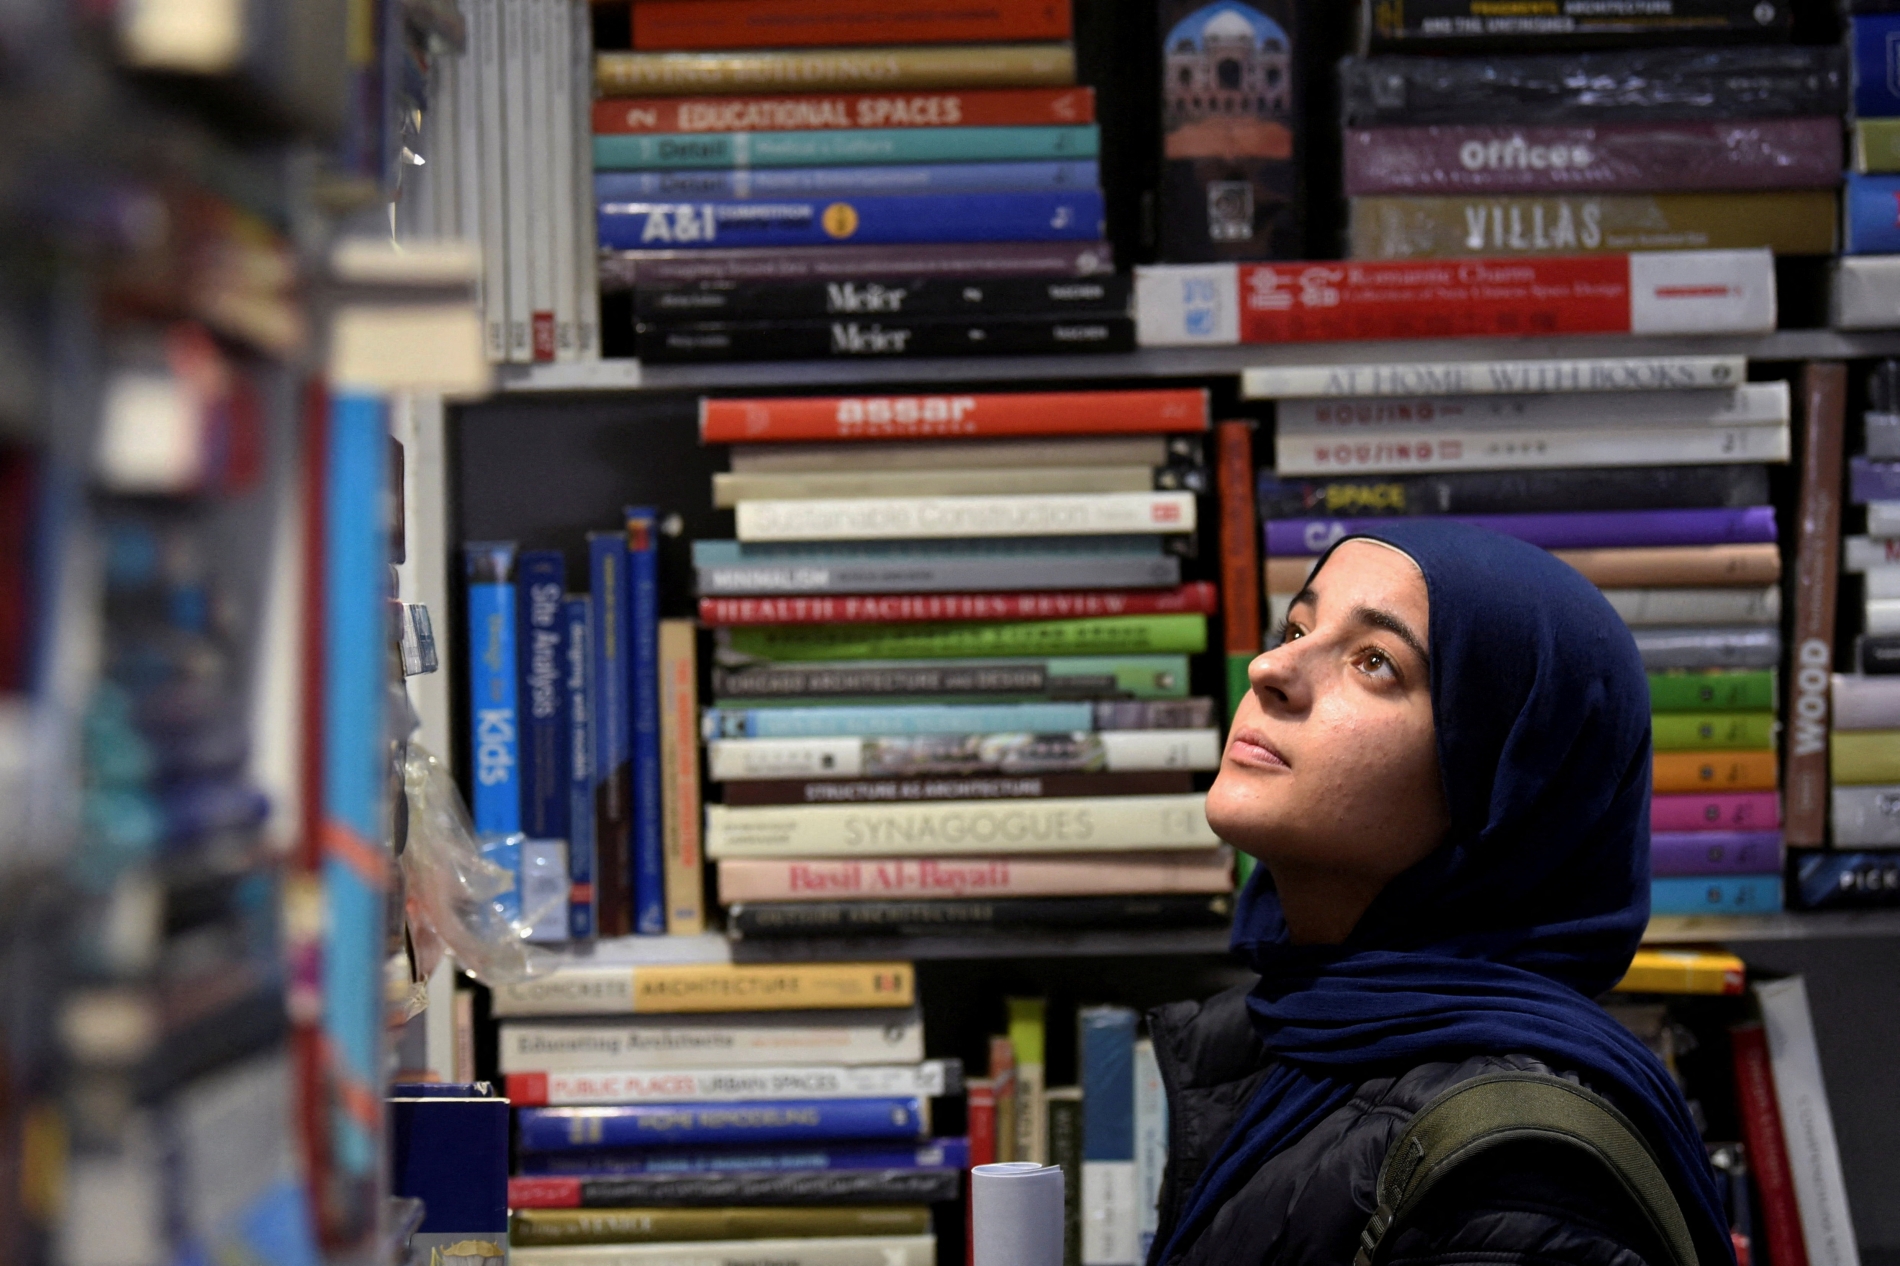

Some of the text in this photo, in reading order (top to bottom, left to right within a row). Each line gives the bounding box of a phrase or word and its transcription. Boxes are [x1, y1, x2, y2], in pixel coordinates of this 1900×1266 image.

[677, 95, 962, 132] EDUCATIONAL SPACES
[658, 139, 728, 160] Detail
[1460, 137, 1593, 170] Offices
[658, 170, 728, 193] Detail
[641, 203, 717, 242] A&I
[1464, 202, 1601, 250] VILLAS
[826, 281, 907, 313] Meier
[830, 321, 912, 353] Meier
[1323, 362, 1696, 395] AT HOME WITH BOOKS
[837, 397, 976, 424] assar
[1326, 483, 1405, 510] SPACE
[755, 499, 1090, 532] Sustainable Construction
[713, 566, 830, 590] MINIMALISM
[717, 592, 1128, 623] HEALTH FACILITIES REVIEW
[527, 629, 562, 720] Analysis
[809, 667, 941, 694] ARCHITECTURE
[977, 666, 1045, 690] DESIGN
[1796, 637, 1829, 757] WOOD
[477, 708, 514, 787] Kids
[805, 782, 899, 801] STRUCTURE
[921, 778, 1043, 798] ARCHITECTURE
[844, 807, 1095, 847] SYNAGOGUES
[789, 859, 1010, 896] Basil Al-Bayati
[507, 979, 630, 1001] CONCRETE
[641, 976, 800, 997] ARCHITECTURE
[518, 1036, 620, 1056] Educating
[627, 1033, 735, 1052] Architects
[553, 1078, 619, 1097] PUBLIC
[626, 1076, 696, 1096] PLACES
[701, 1076, 766, 1094] URBAN
[772, 1075, 839, 1093] SPACES
